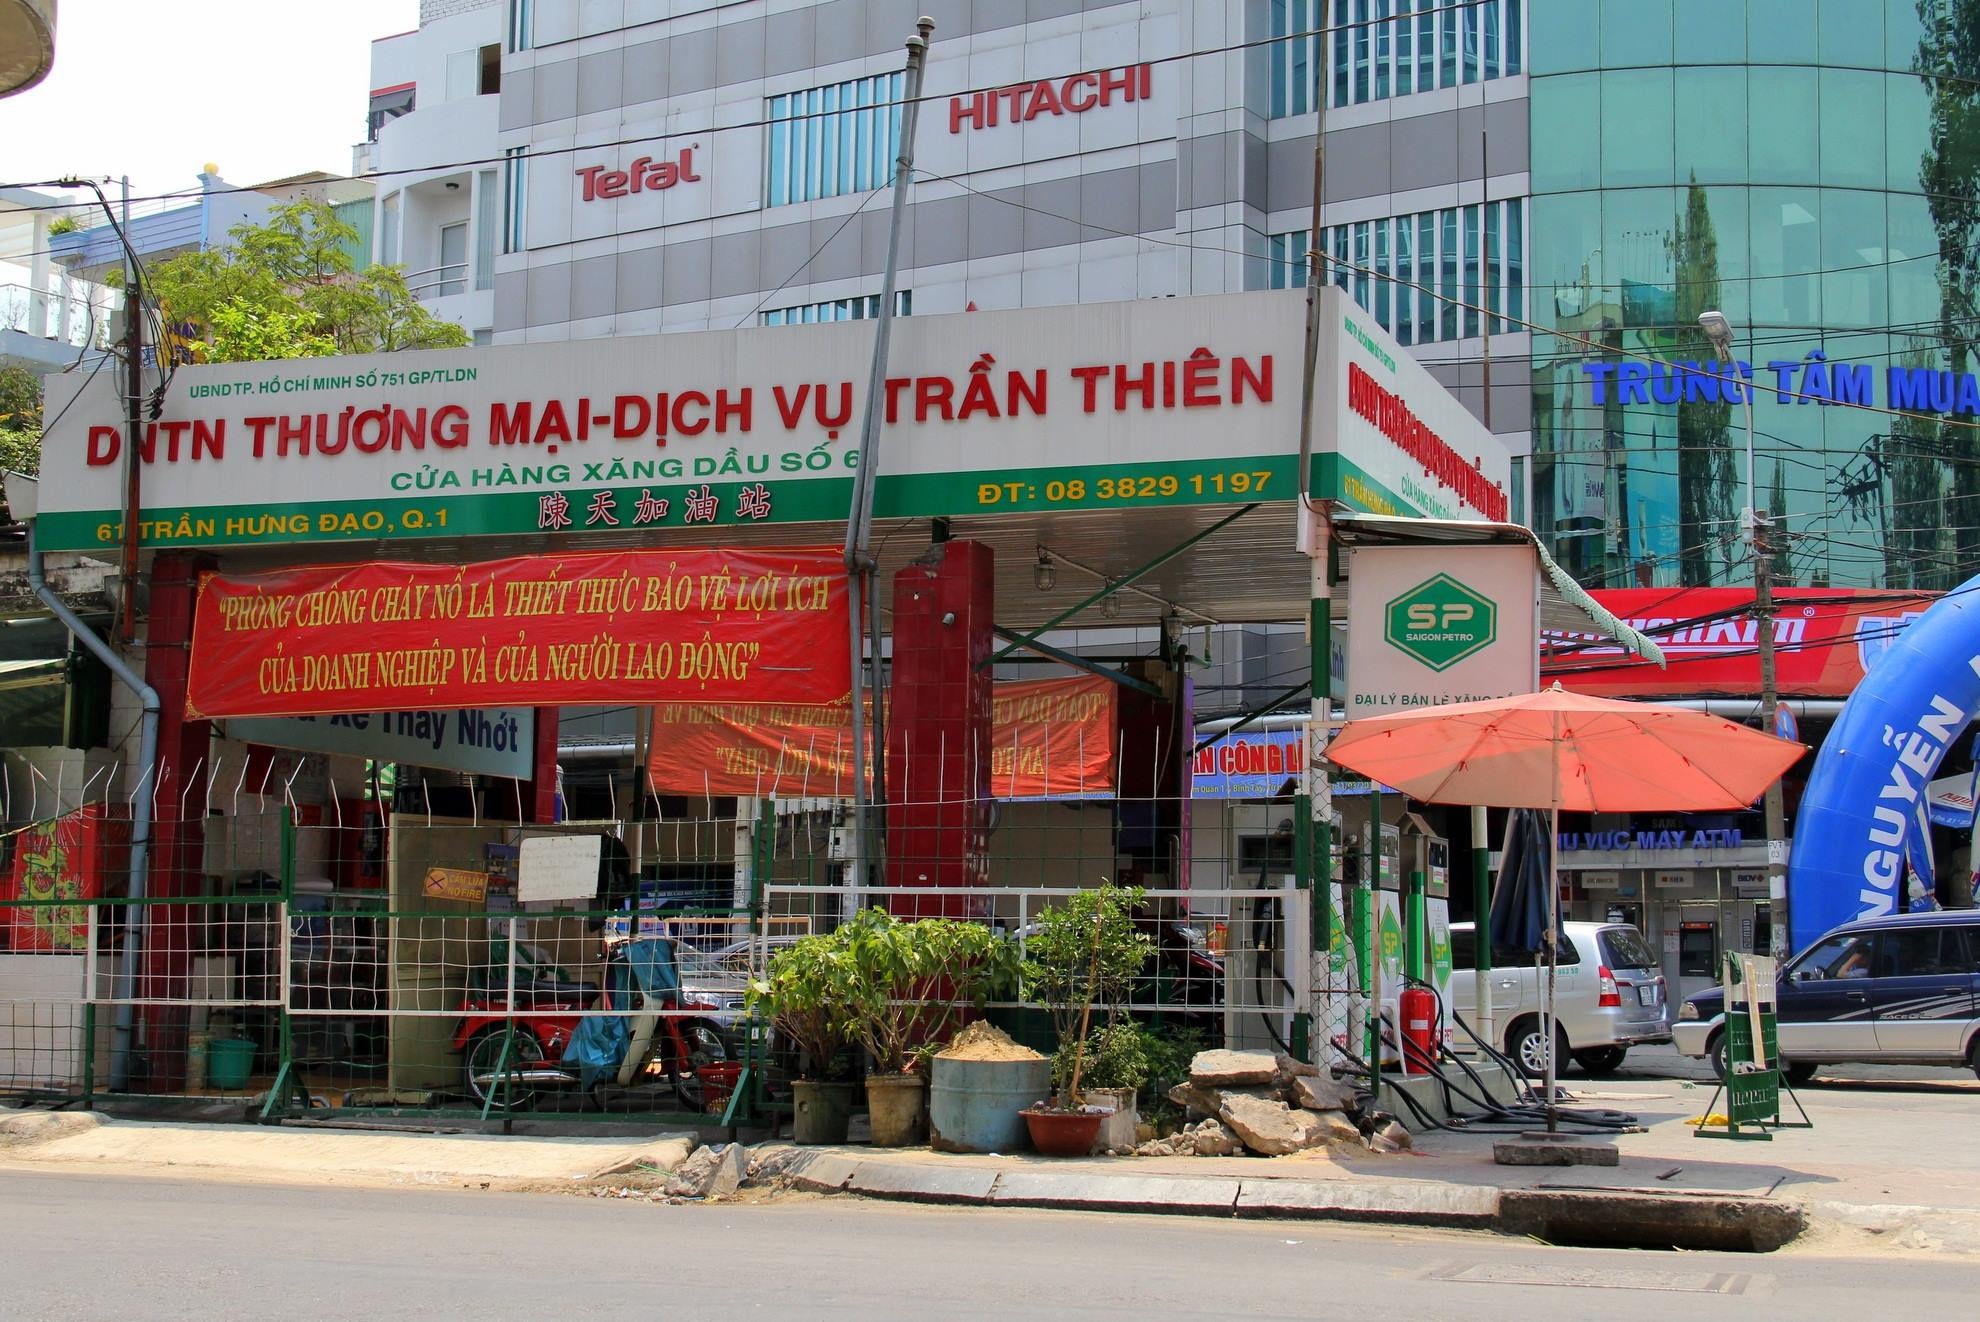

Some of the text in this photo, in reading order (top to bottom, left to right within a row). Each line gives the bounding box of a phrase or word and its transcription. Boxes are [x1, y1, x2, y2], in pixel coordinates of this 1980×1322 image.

[949, 63, 1151, 135] HITACHI
[575, 147, 701, 202] Tefal
[189, 368, 478, 398] UBND TP. HỒ CHÍ MINH SỐ 751 GP/TLDN
[1583, 349, 1980, 416] TRUNG TÂM MUA
[86, 347, 1273, 467] DNTN THƯƠNG MẠI-DỊCH VỤ TRẦN THIÊN
[390, 464, 461, 491] CỬA
[472, 463, 571, 487] HÀNG
[582, 457, 684, 482] XĂNG
[694, 447, 769, 477] DẦU
[780, 441, 832, 473] SỐ
[977, 471, 1272, 505] ĐT: 08 3829 1197
[138, 512, 215, 540] TRẦN
[226, 513, 310, 536] HƯNG
[319, 511, 395, 536] ĐẠO,
[402, 509, 449, 529] Q.1
[539, 483, 772, 530] 陳天加油站
[371, 573, 424, 623] CHÁY
[430, 565, 467, 619] NỔ
[467, 572, 495, 619] LÀ
[503, 562, 572, 617] THIẾT
[575, 569, 640, 622] THỰC
[642, 561, 692, 612] BẢO
[699, 564, 733, 620] VỆ
[734, 569, 781, 621] LỢI
[784, 564, 831, 611] ÍCH
[1405, 633, 1474, 642] SAIGON PETRO
[1407, 603, 1474, 630] SP
[259, 642, 297, 694] CỦA
[302, 651, 372, 693] DOANH
[374, 638, 455, 695] NGHIỆP
[461, 635, 487, 684] VÀ
[495, 630, 539, 683] CỦA
[545, 631, 622, 682] NGƯỜI
[624, 642, 673, 681] LAO
[1355, 694, 1377, 707] ĐẠI
[1380, 692, 1397, 705] LÝ
[1401, 692, 1429, 706] BÁN
[458, 708, 518, 753] Nhớt
[1219, 740, 1283, 775] CÔNG
[1856, 694, 1965, 921] NGUYỄN
[1692, 828, 1742, 849] ATM
